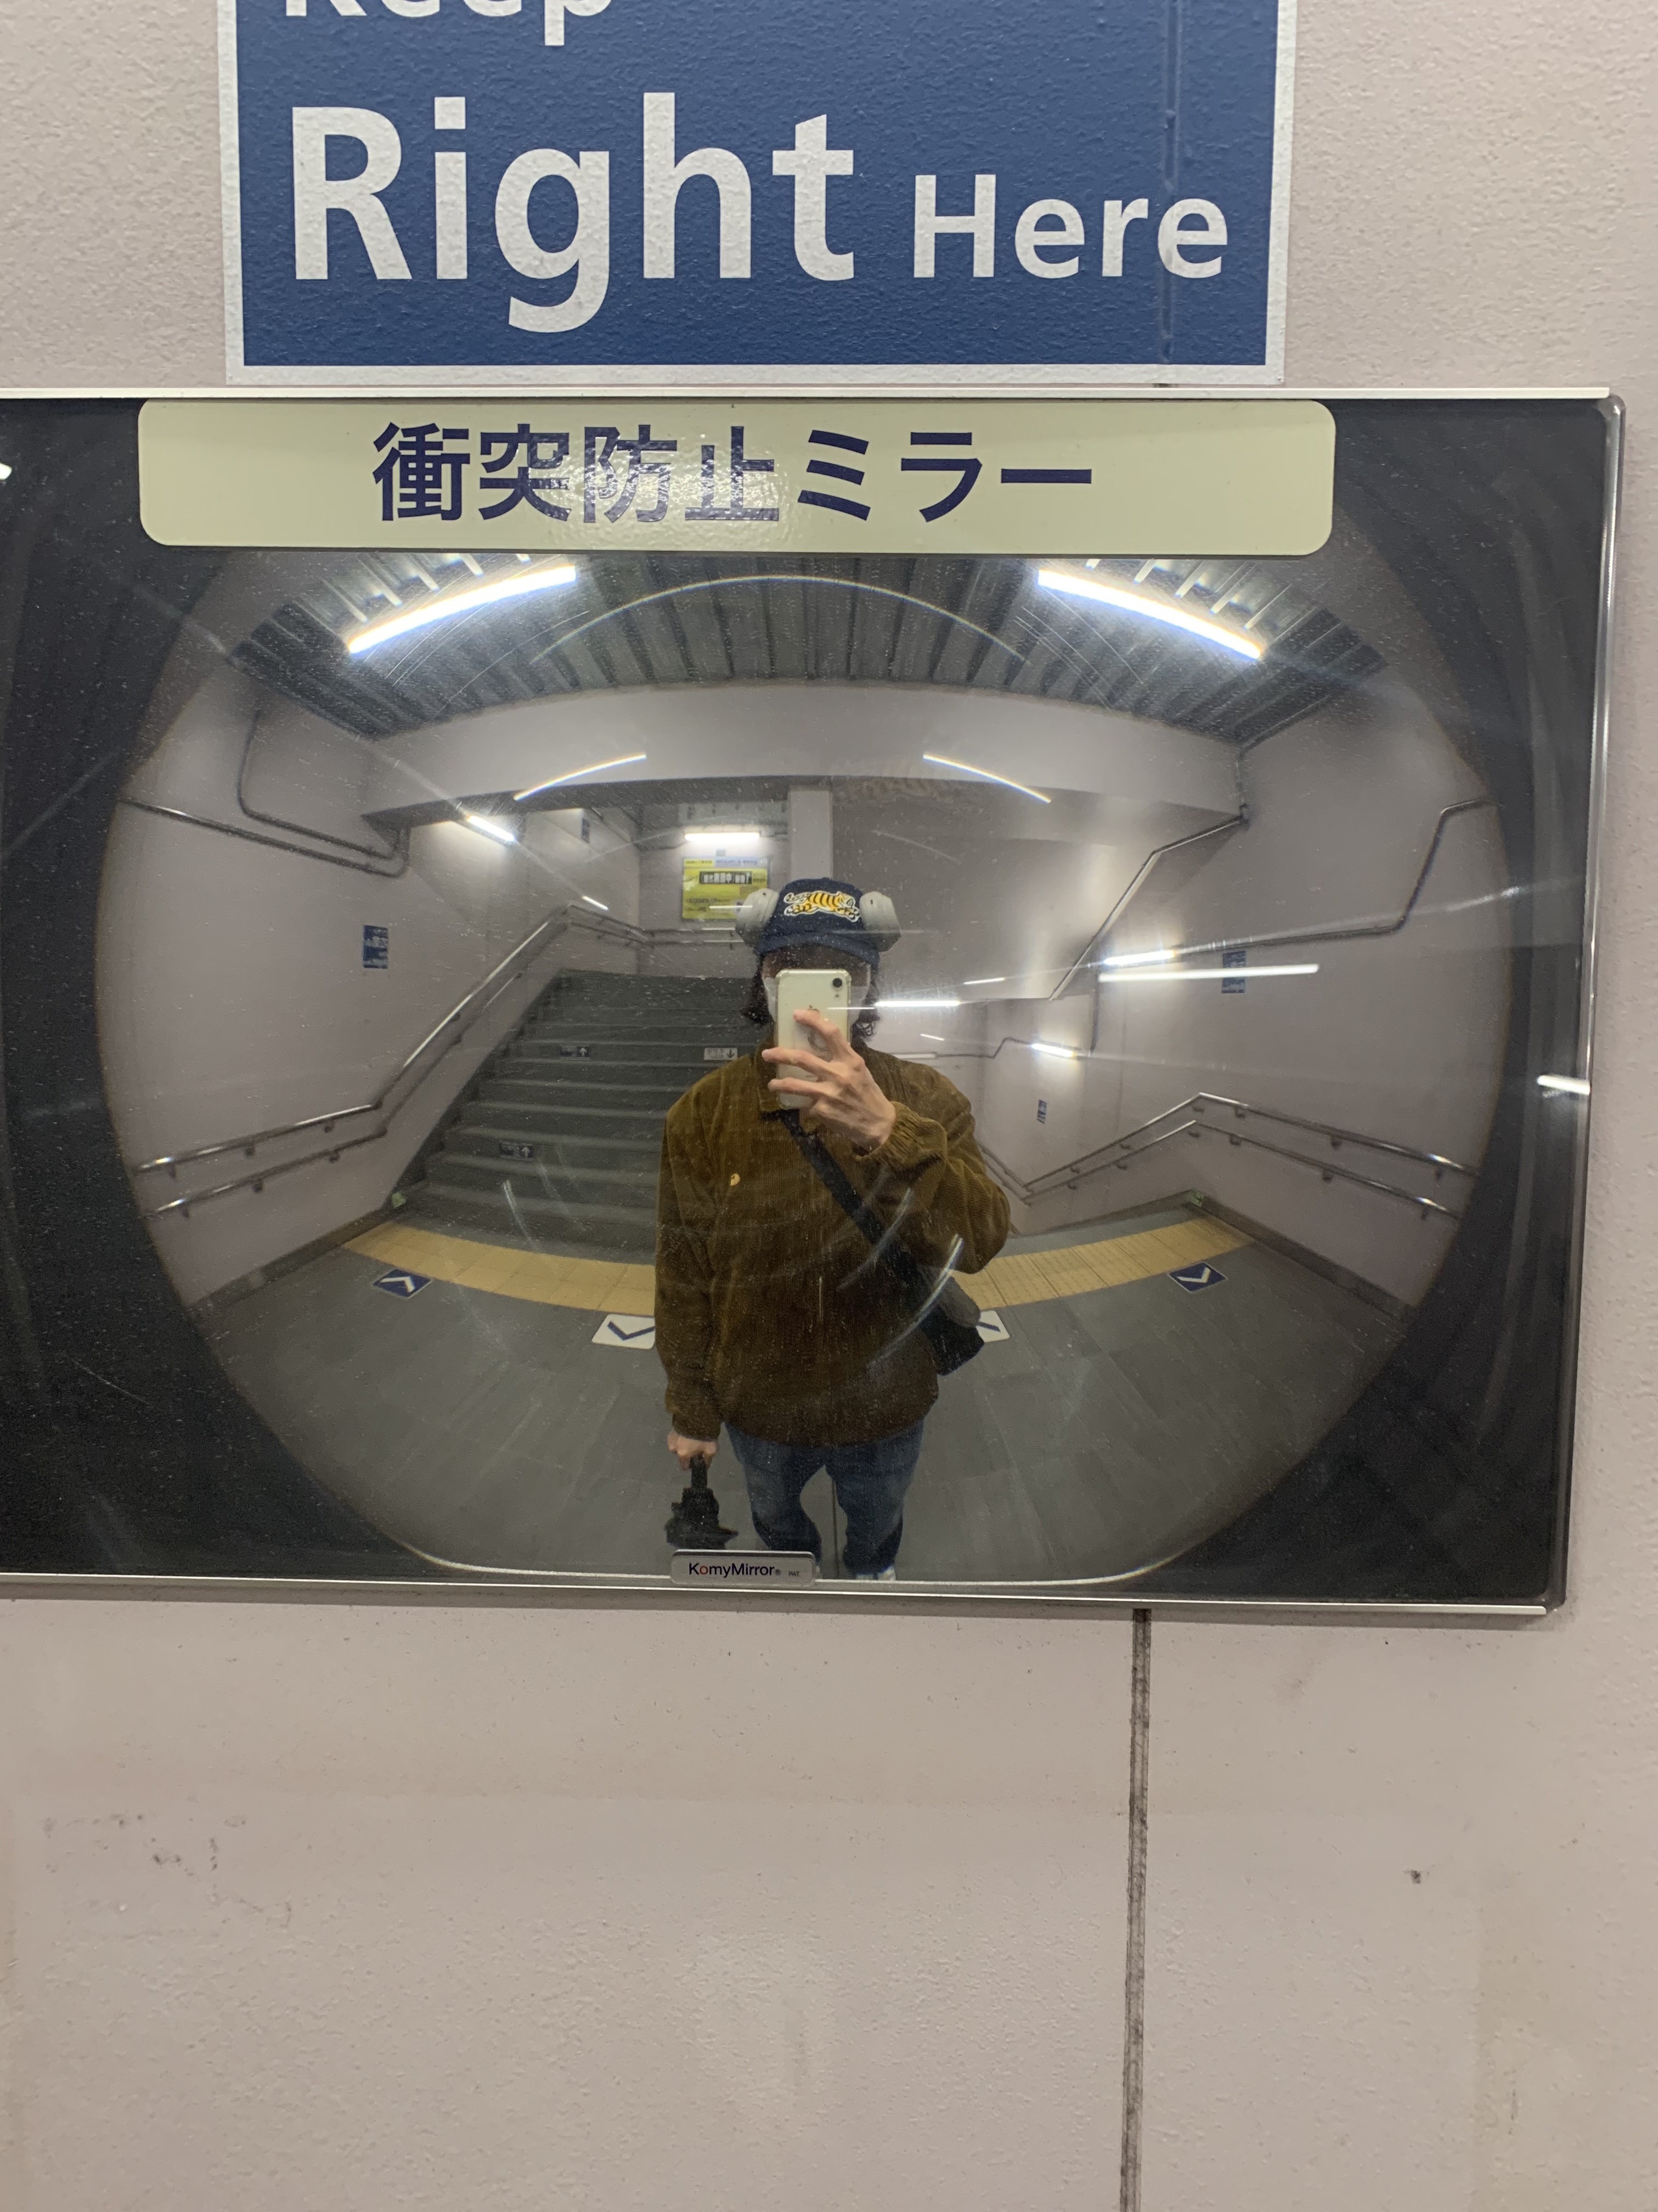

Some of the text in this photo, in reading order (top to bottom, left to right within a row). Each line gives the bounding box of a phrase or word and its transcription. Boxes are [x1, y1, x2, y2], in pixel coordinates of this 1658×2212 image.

[290, 92, 1228, 333] Right Here
[372, 421, 1093, 524] 衝突防止ミラー
